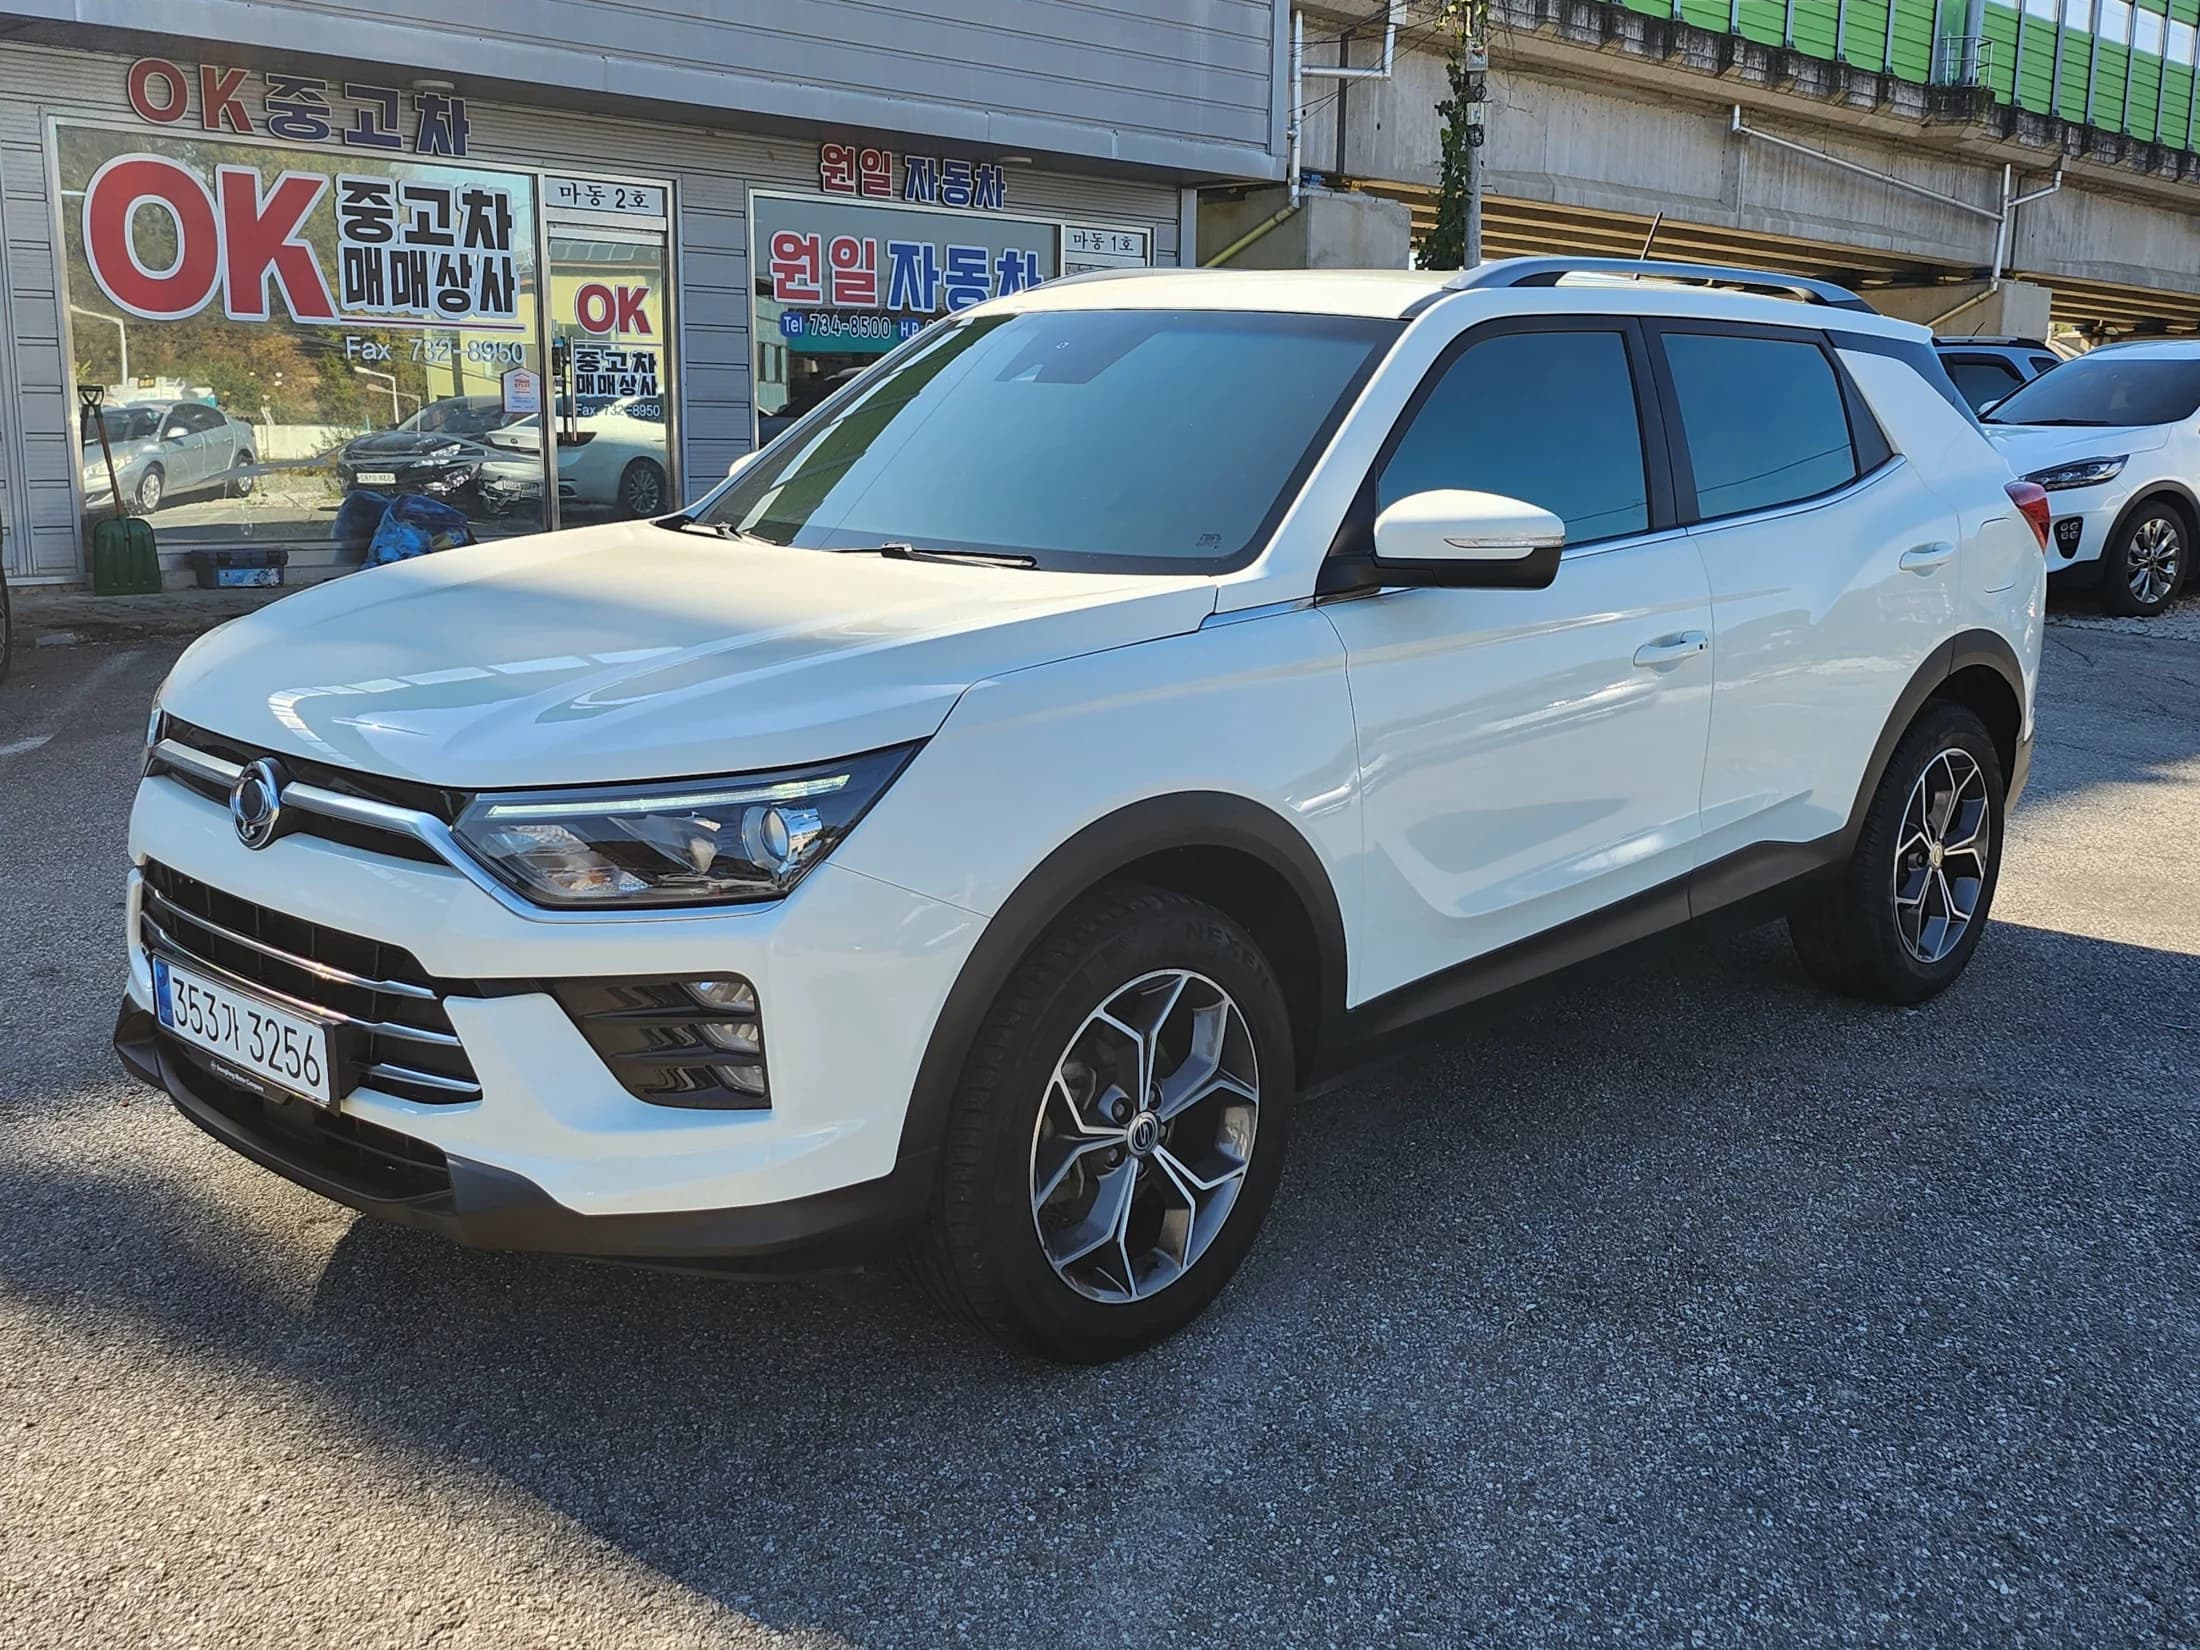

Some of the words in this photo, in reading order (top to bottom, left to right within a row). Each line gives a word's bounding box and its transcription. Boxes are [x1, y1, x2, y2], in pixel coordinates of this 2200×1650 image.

[558, 181, 606, 207] 마동
[615, 188, 650, 209] 2호
[820, 143, 893, 198] 원일
[904, 155, 1008, 210] 자동차
[340, 178, 515, 251] 중고차
[83, 153, 340, 323] OK
[1073, 230, 1104, 250] 마동
[1111, 234, 1134, 252] 1호
[343, 247, 516, 313] 매매상사
[770, 230, 878, 307] 원일
[887, 240, 1043, 314] 자동차
[575, 282, 653, 336] OK
[783, 315, 803, 333] Tel
[809, 313, 891, 339] 734-8500
[346, 336, 391, 361] Fax
[408, 338, 525, 364] 732-8950
[575, 350, 657, 374] 중고차
[575, 373, 658, 396] 매매상사
[575, 403, 597, 416] Fax
[603, 404, 661, 417] 732-8950
[172, 976, 240, 1051] 353가
[247, 1009, 321, 1087] 3256
